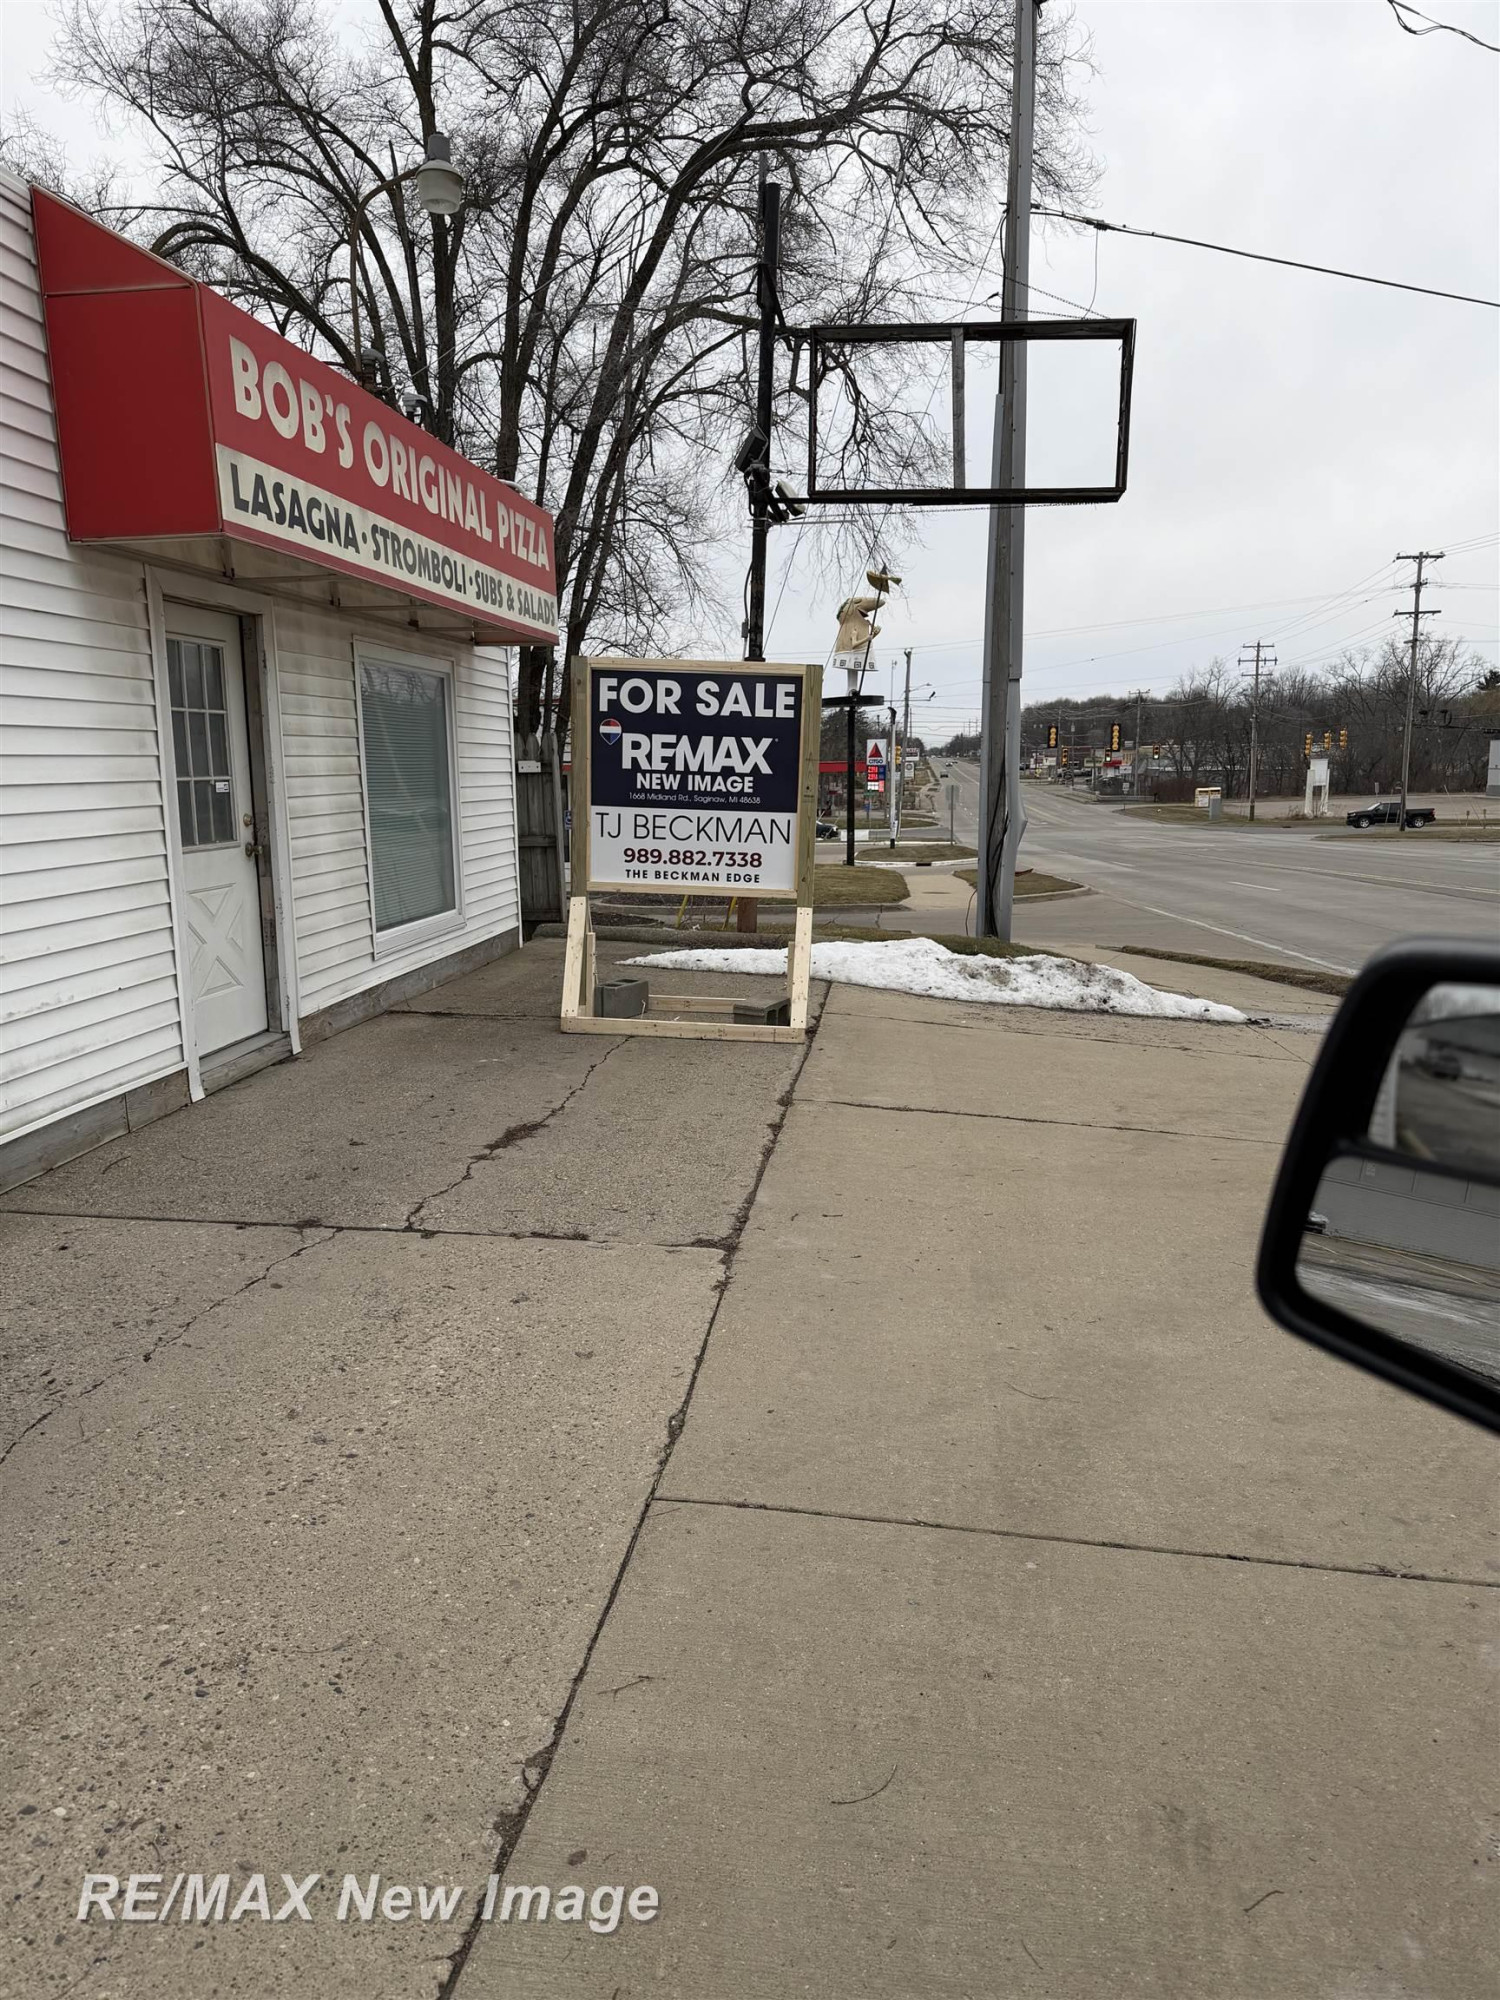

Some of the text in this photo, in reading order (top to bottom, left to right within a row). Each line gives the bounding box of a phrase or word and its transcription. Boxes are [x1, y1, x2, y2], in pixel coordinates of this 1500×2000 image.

[229, 335, 550, 572] BOB'S ORIGINAL PIZZA
[230, 462, 556, 627] LASAGNA STROMBOLI SUBS & SALADS
[599, 677, 796, 719] FOR SALE
[636, 772, 754, 793] NEW IMAGE
[629, 792, 646, 800] 1668
[647, 792, 677, 802] Midland
[694, 794, 727, 805] Saginaw,
[728, 796, 738, 804] MI
[739, 796, 761, 804] 48638
[595, 812, 791, 845] TJ BECKMAN
[623, 847, 763, 868] 989.882.7338
[625, 869, 761, 884] THE BECKMAN EDGE
